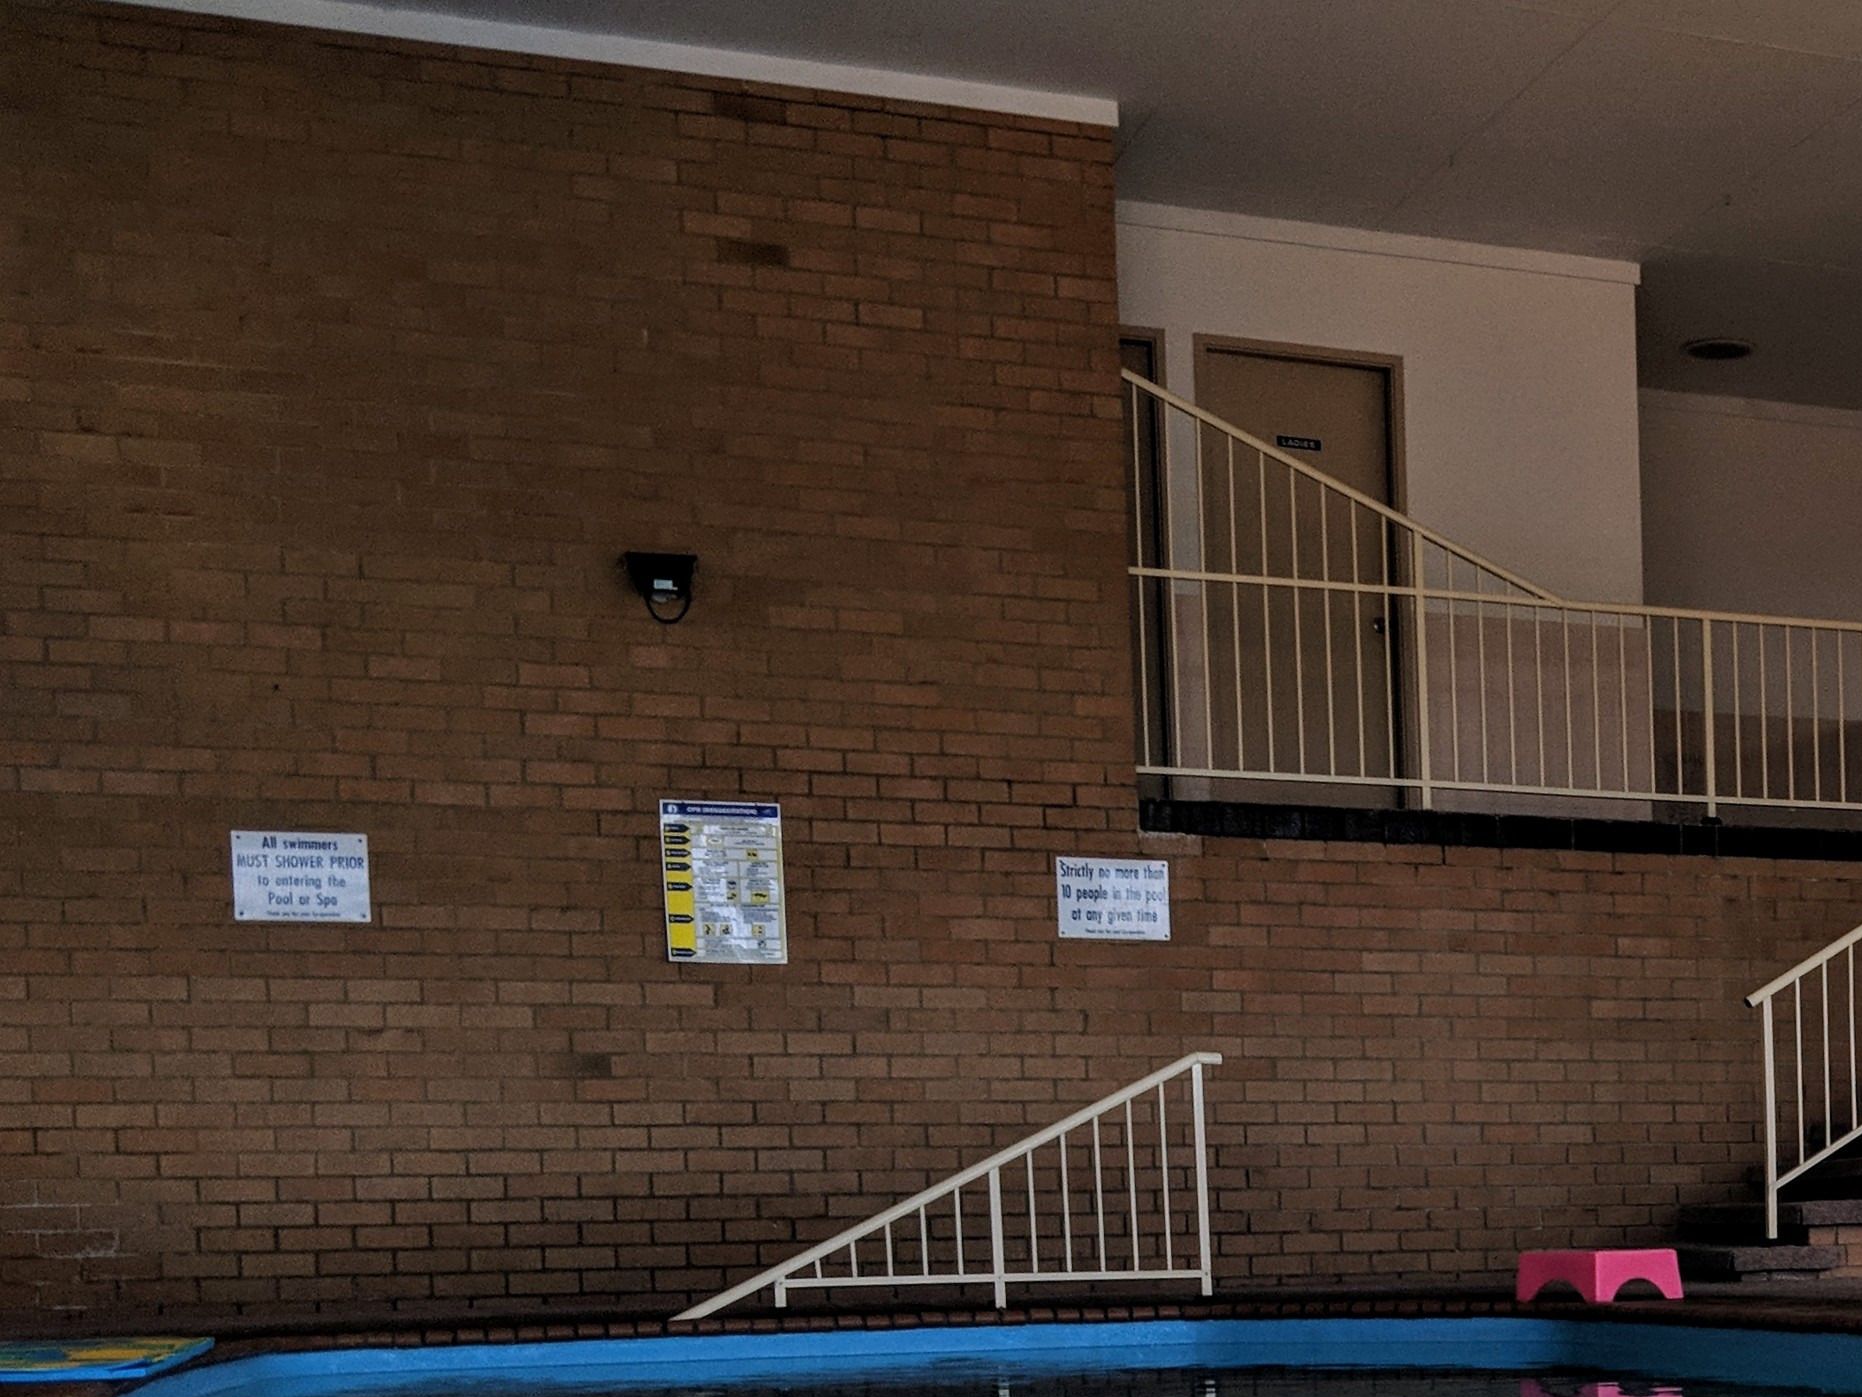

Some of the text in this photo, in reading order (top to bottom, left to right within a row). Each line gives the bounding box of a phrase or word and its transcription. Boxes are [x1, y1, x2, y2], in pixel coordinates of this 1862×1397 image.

[262, 836, 338, 851] All swimmers
[237, 854, 364, 869] MUST SHOWER PRIOR
[1060, 862, 1164, 880] Strictly no more than
[258, 875, 346, 889] to entering the
[268, 893, 338, 908] Pool or Spa
[1061, 884, 1166, 903] 10 people in the pool
[1072, 908, 1158, 924] at any given time
